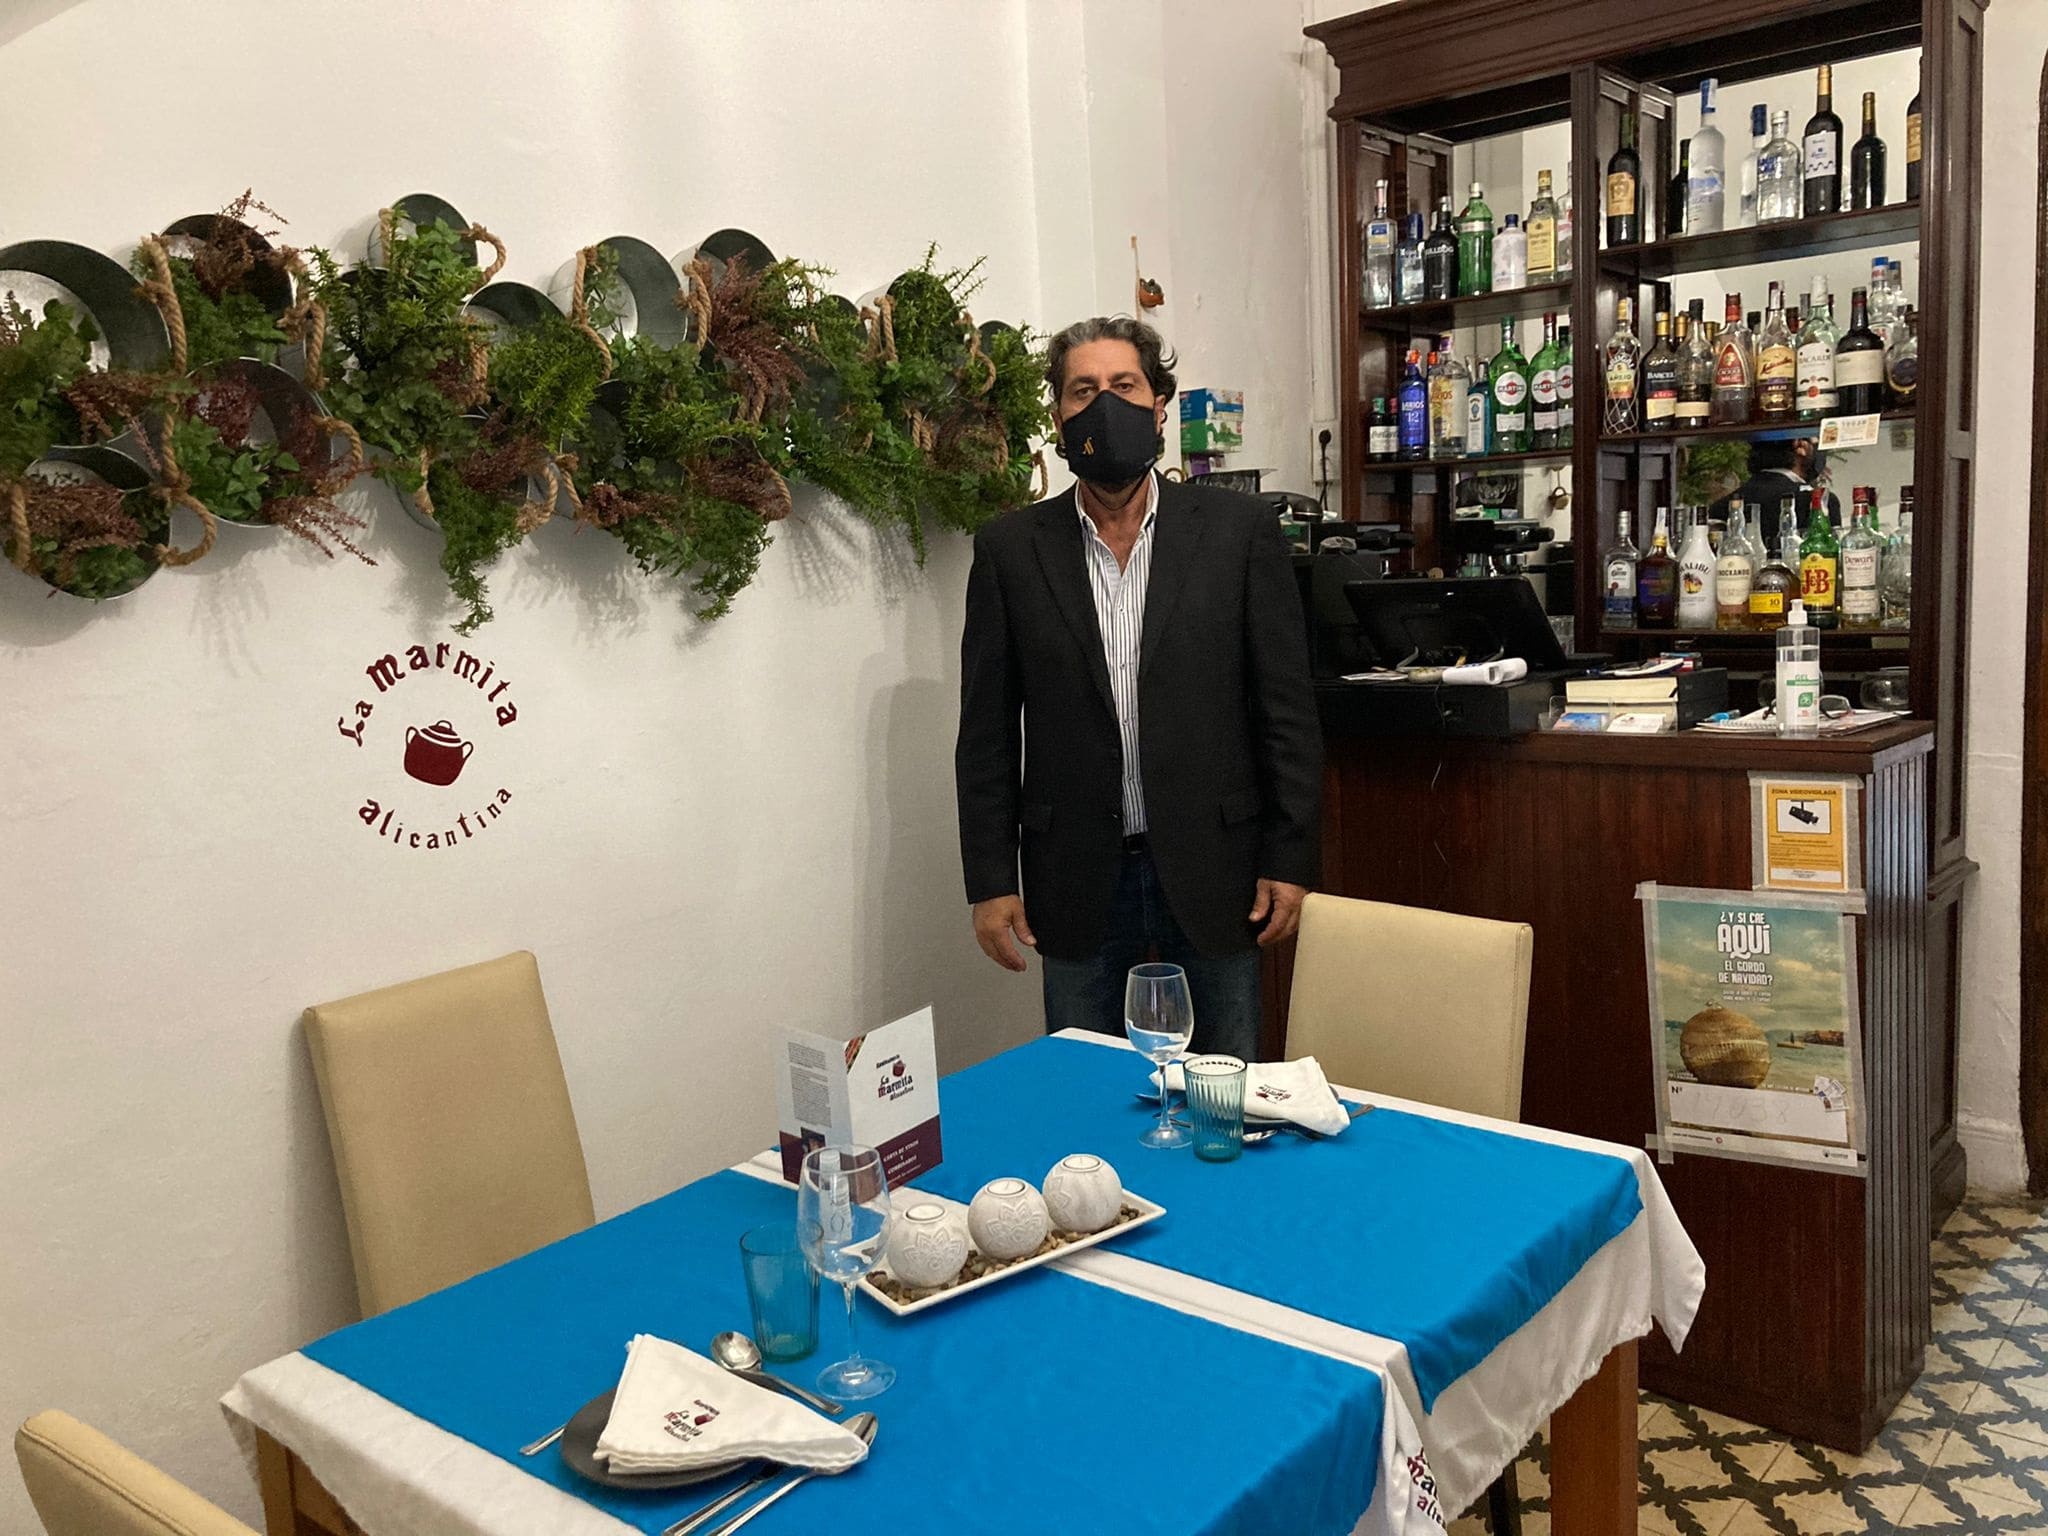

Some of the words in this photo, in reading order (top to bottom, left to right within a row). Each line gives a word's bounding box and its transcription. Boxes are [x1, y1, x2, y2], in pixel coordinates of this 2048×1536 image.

[338, 700, 373, 747] La
[358, 788, 512, 849] alicantina
[1738, 912, 1746, 924] SI
[1749, 912, 1766, 925] CAE
[1725, 960, 1734, 972] EL
[1737, 961, 1765, 973] GORDO
[1718, 972, 1729, 983] DE
